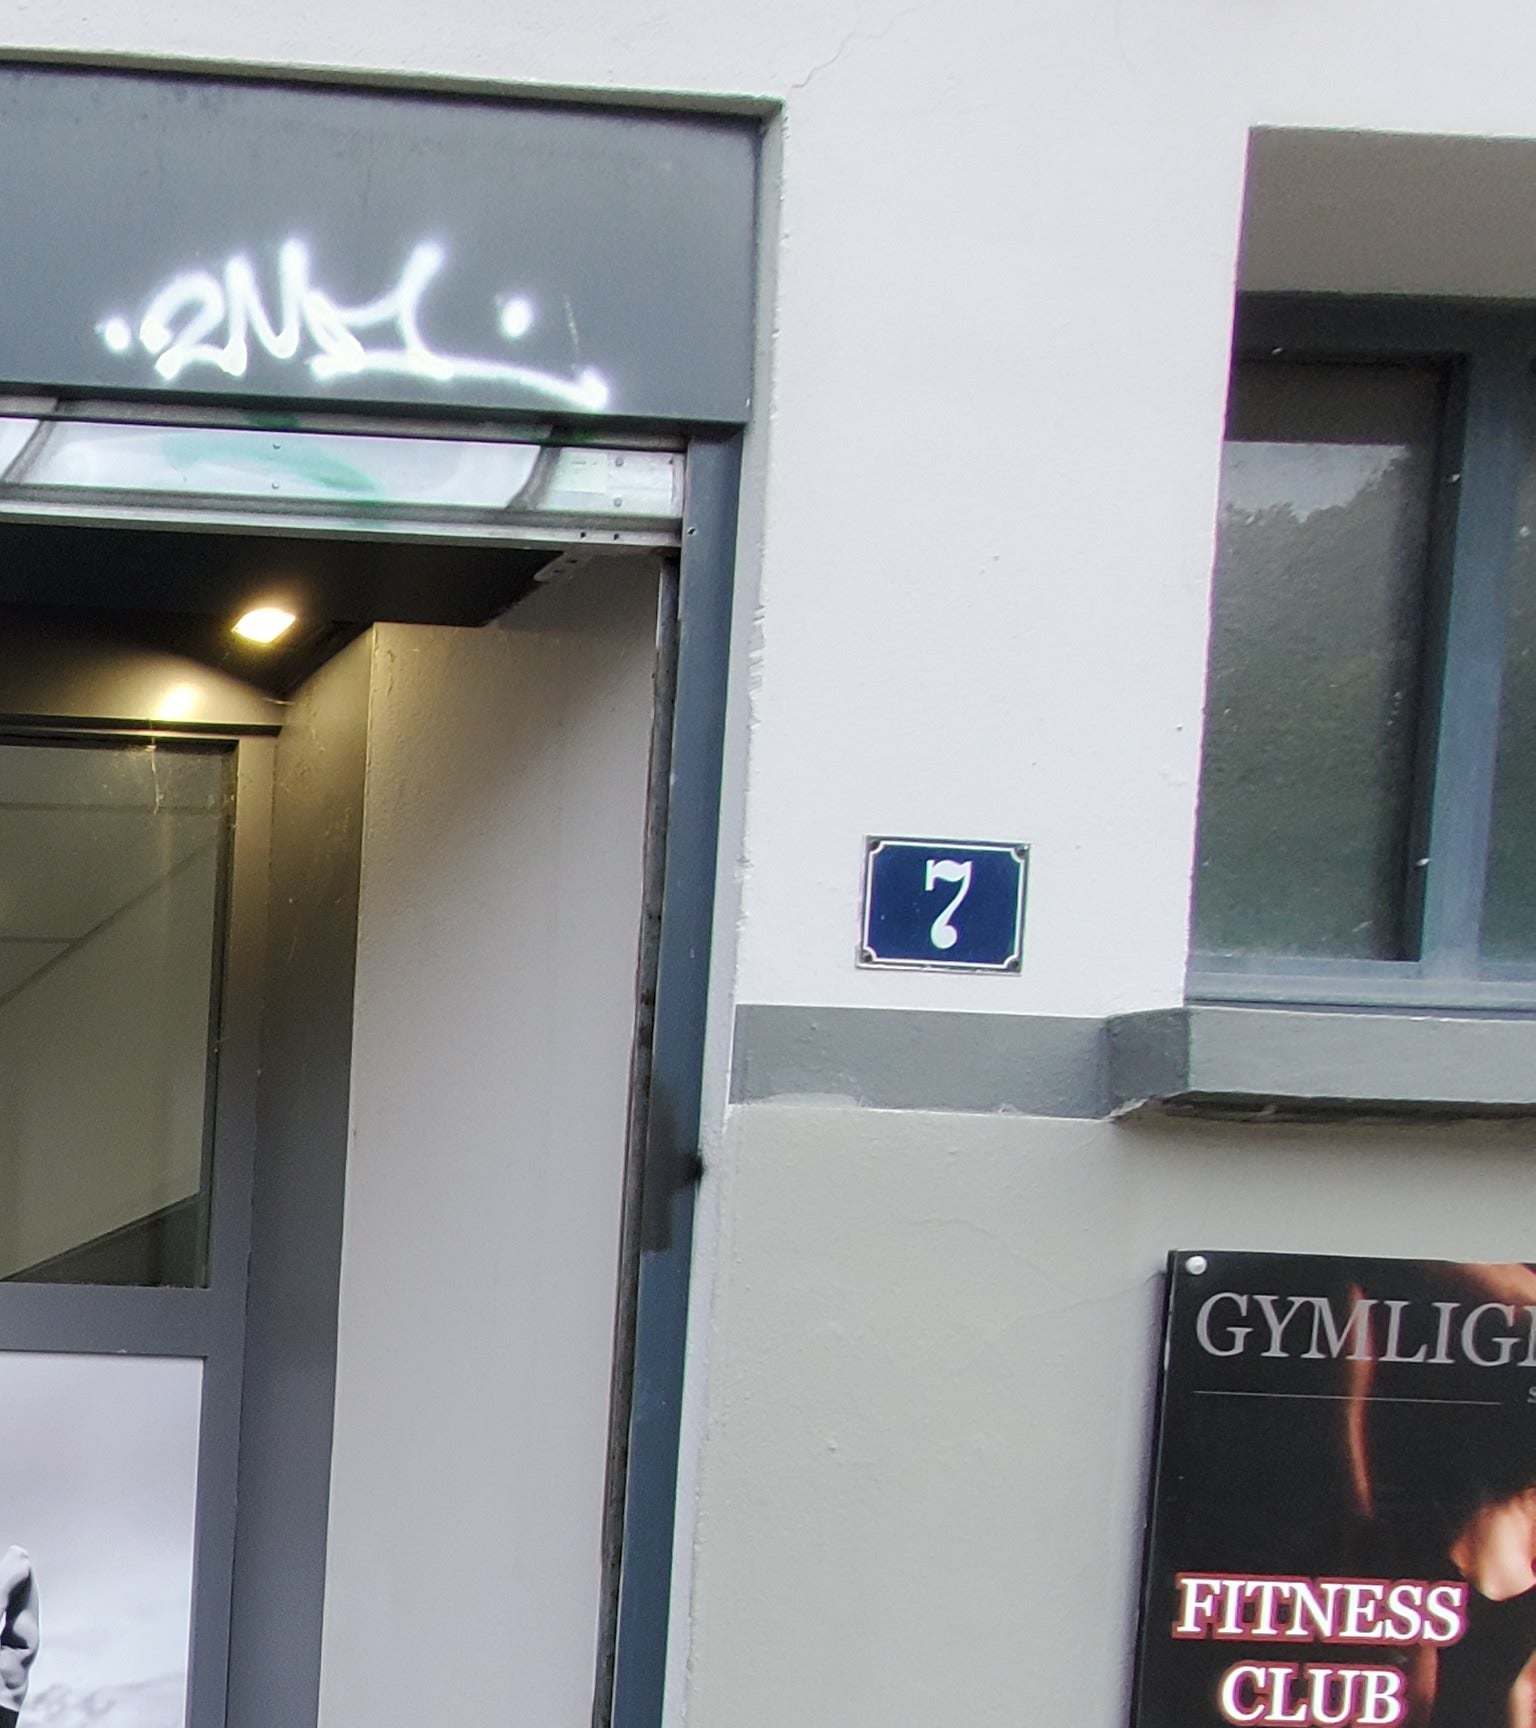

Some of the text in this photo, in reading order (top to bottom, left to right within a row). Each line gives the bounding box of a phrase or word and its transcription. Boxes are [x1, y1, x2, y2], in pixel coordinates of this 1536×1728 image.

[925, 859, 972, 949] 7
[1196, 1292, 1536, 1367] GYMLIG
[1176, 1576, 1464, 1642] FITNESS
[1222, 1664, 1404, 1726] CLUB
